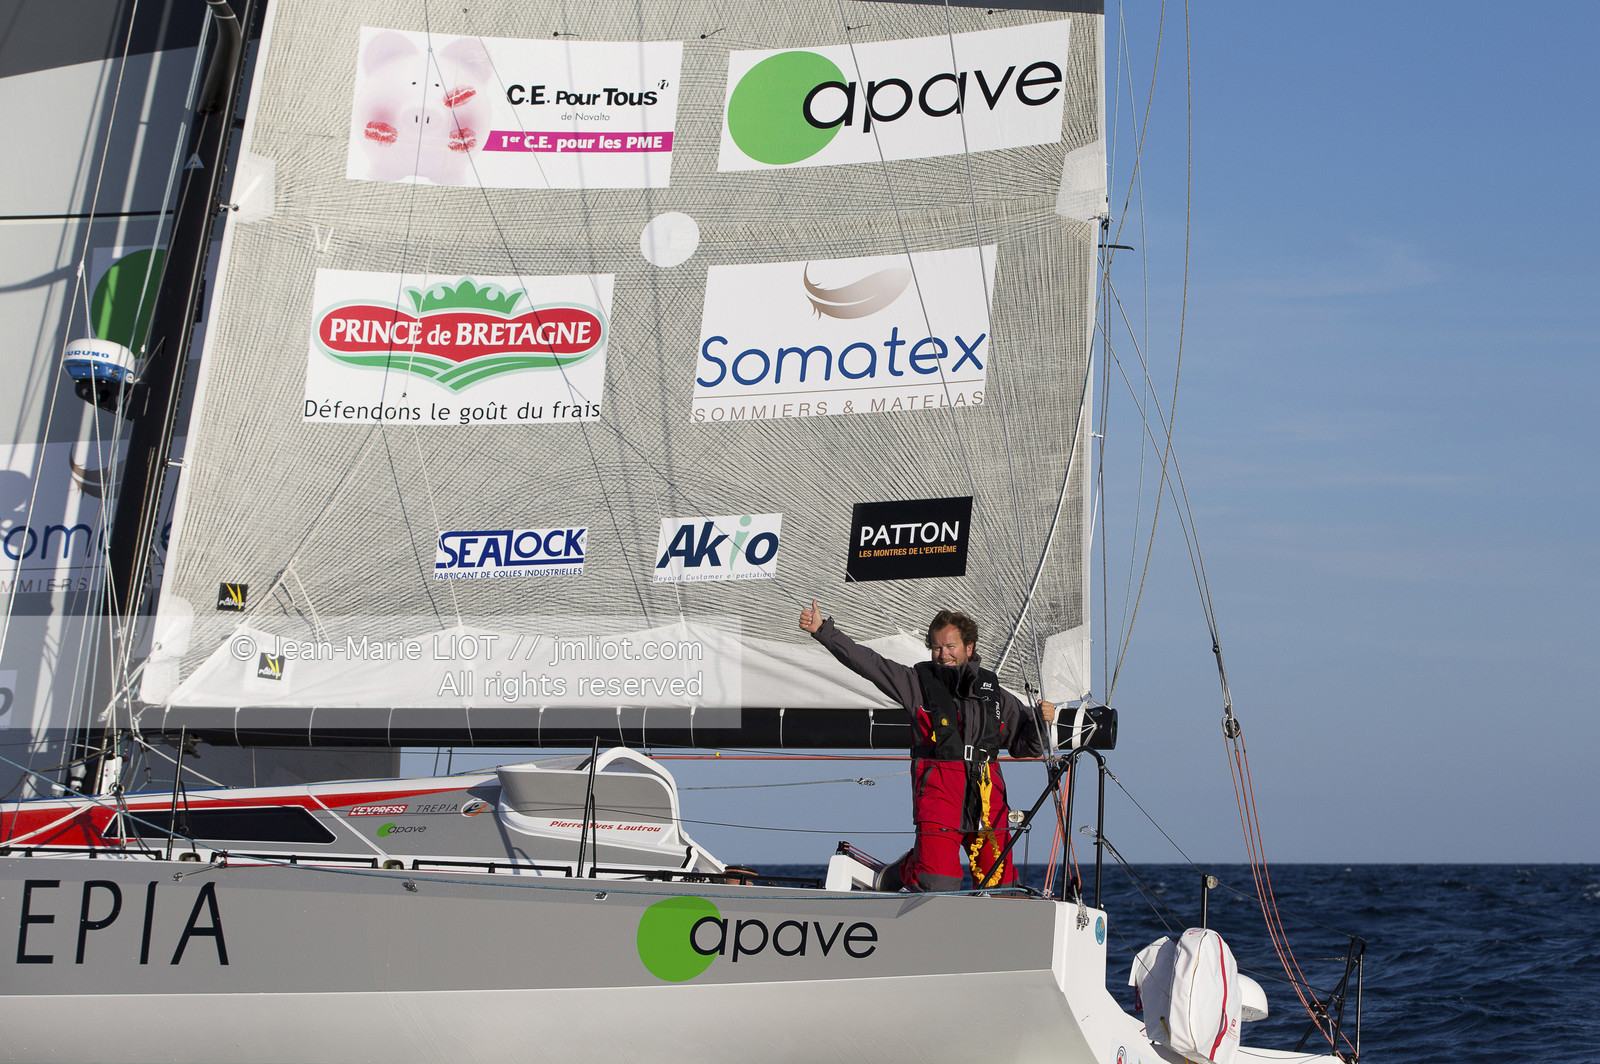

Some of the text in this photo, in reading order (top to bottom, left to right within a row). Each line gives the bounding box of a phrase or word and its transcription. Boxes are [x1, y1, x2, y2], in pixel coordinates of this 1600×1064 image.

[507, 84, 657, 106] C.E. Pour Tous
[803, 61, 1062, 133] apave
[561, 112, 611, 121] de Novalto
[501, 136, 663, 152] 1er C.E. pour les PME
[329, 318, 591, 346] PRINCE de BRETAGNE
[65, 350, 110, 358] URUNO
[696, 326, 987, 388] Somatex
[304, 398, 600, 425] Défendons le goût du frais
[694, 391, 984, 422] SOMMIERS & MATELAS
[656, 515, 779, 572] Akio
[860, 521, 959, 547] PATTON
[435, 529, 586, 568] SEALOCK
[859, 544, 957, 558] LES MONTRES DE L'EXTRÊME
[434, 567, 583, 580] FABRICANT DE COLLES INDUSTRIELLES
[350, 804, 458, 816] L'EXPRESS TREPIA
[387, 825, 427, 834] apave
[550, 821, 584, 829] Pierre
[617, 824, 661, 832] Lautrou
[16, 880, 229, 965] EPIA
[690, 916, 878, 962] apave
